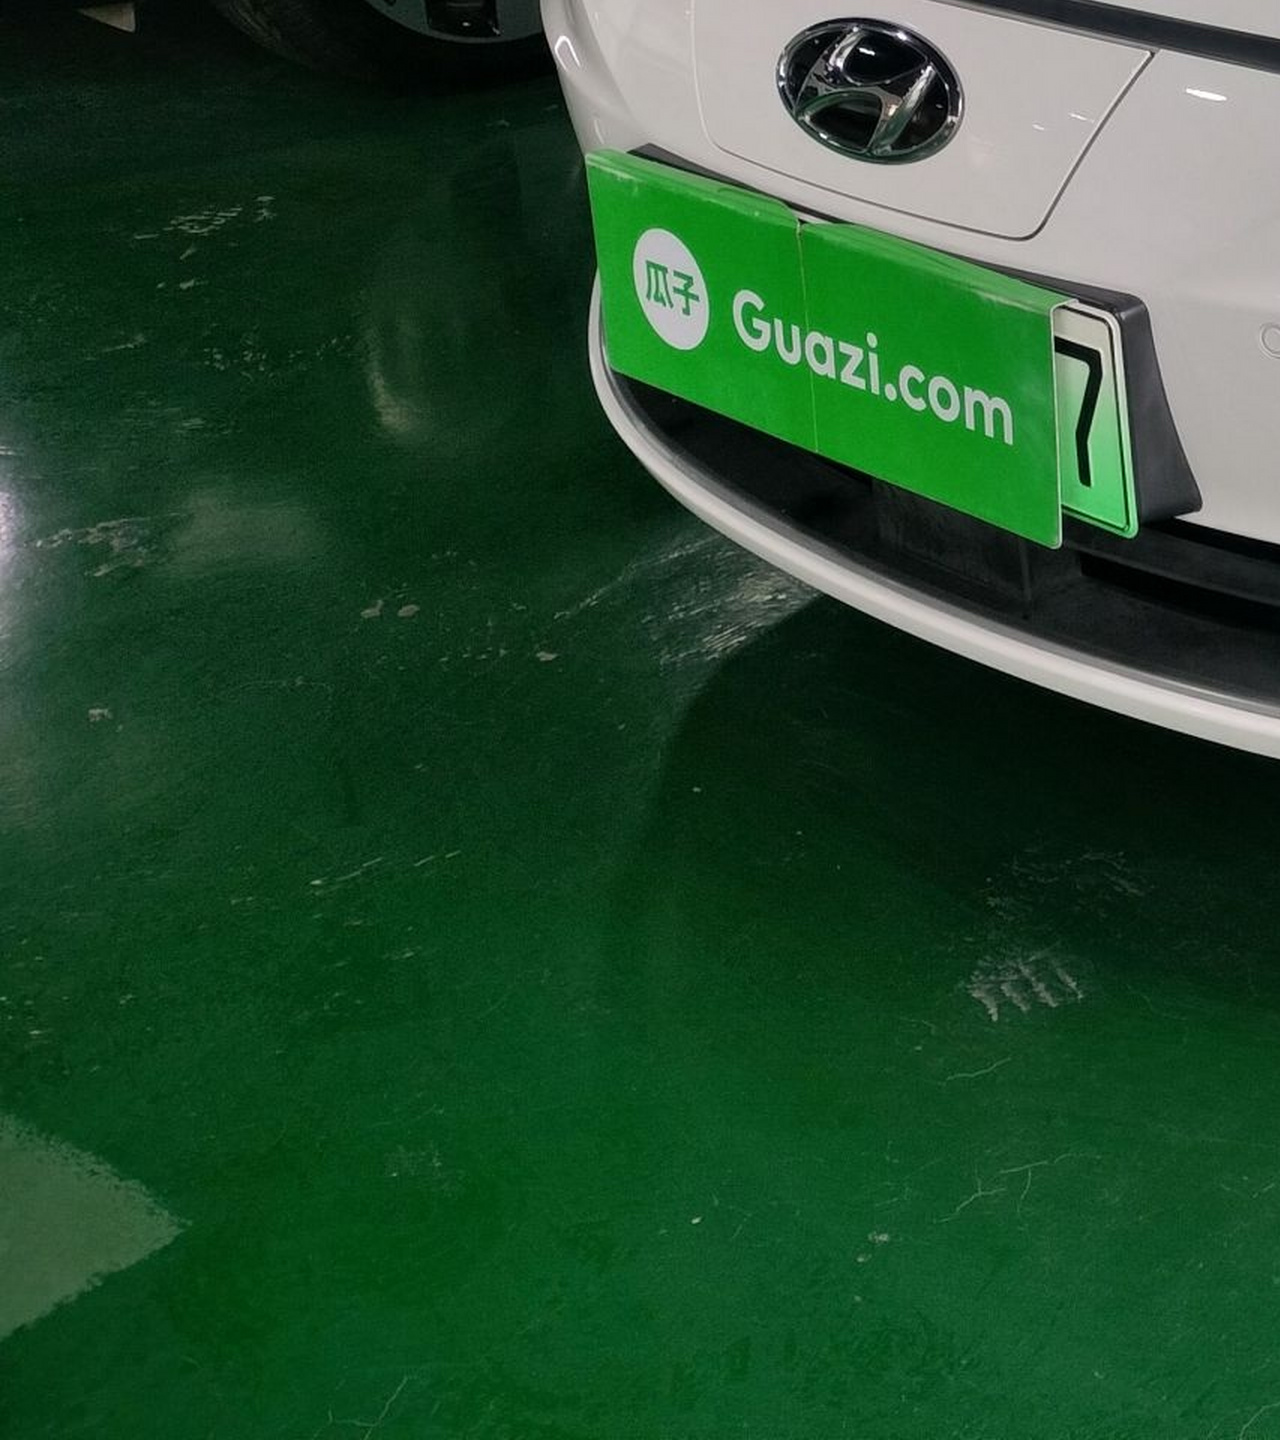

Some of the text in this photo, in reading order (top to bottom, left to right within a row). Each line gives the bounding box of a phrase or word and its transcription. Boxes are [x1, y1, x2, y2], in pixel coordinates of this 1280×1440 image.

[644, 259, 700, 317] 瓜子
[732, 289, 1014, 445] Guazi.com
[1055, 334, 1104, 488] 7
